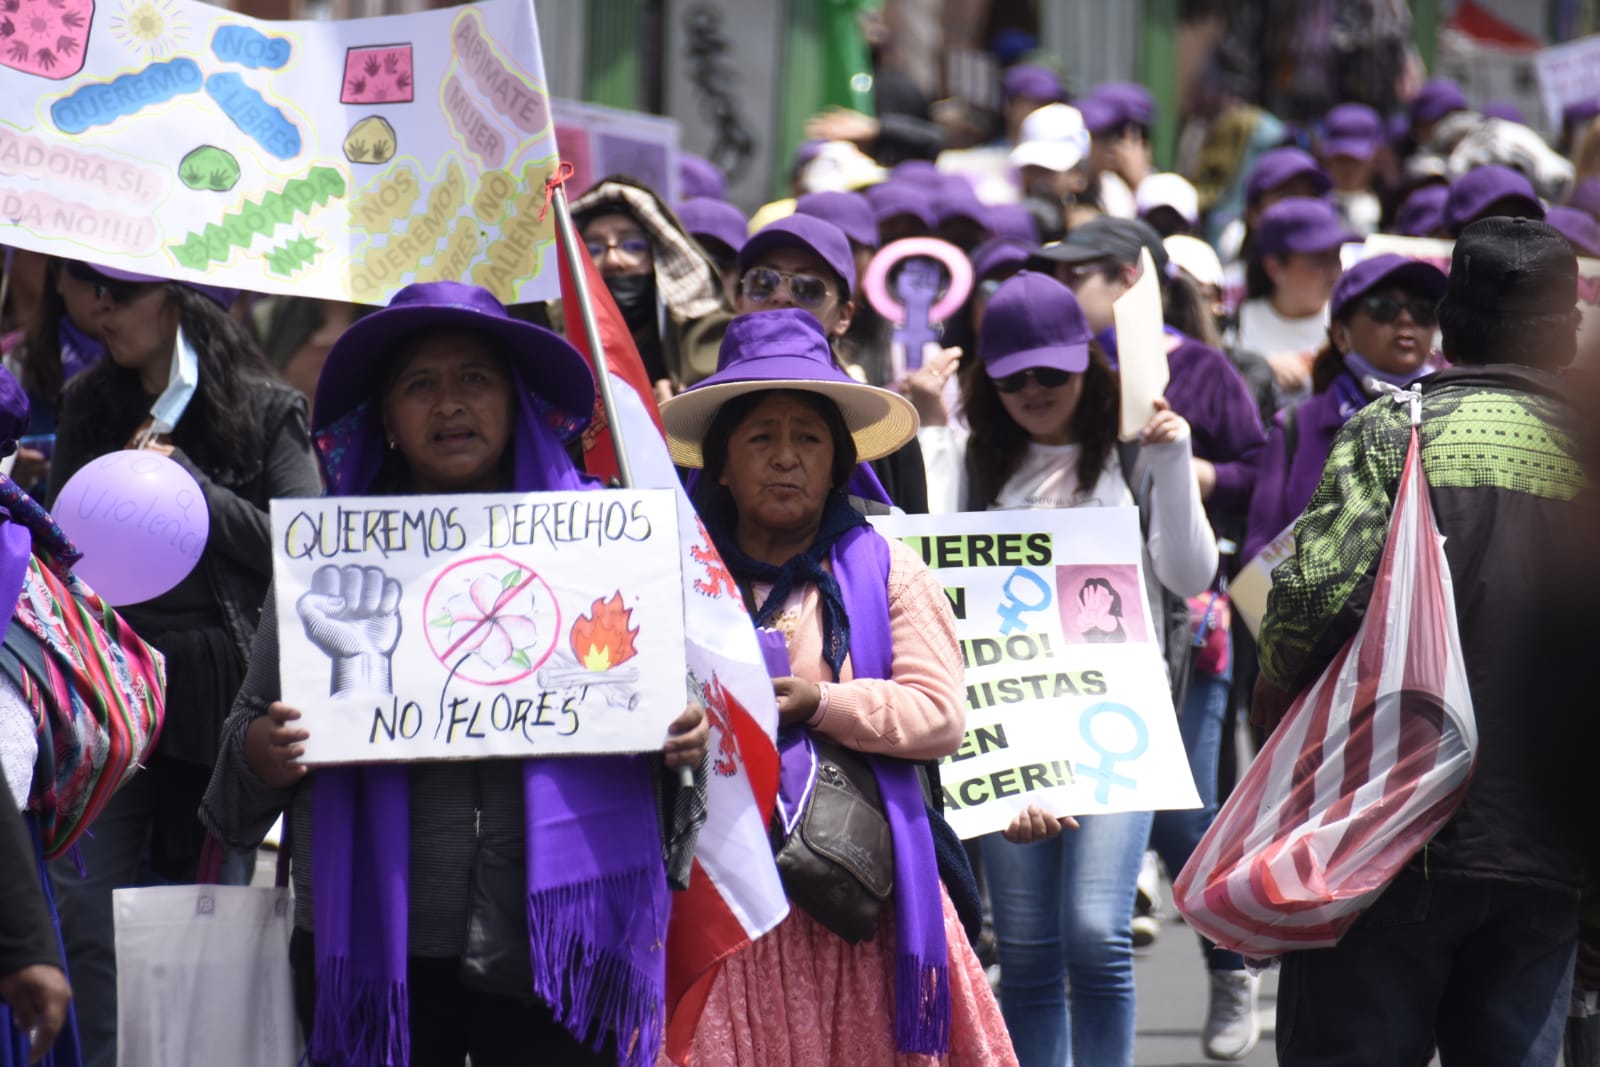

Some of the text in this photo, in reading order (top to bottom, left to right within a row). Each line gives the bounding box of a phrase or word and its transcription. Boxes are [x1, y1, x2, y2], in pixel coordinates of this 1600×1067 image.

[222, 34, 281, 66] NOS
[54, 60, 200, 128] QUEREMO
[227, 90, 299, 158] LIBRES
[449, 84, 500, 160] MUJER
[0, 135, 151, 204] ADORA SI,
[361, 173, 413, 224] NOS
[478, 176, 510, 220] NO
[184, 170, 341, 266] EXPLOTADA
[350, 168, 460, 296] QUEREMOS
[274, 240, 312, 269] NO
[284, 500, 652, 561] QUEREMOS DERECHOS
[896, 532, 1053, 569] ERES
[368, 695, 424, 745] NO
